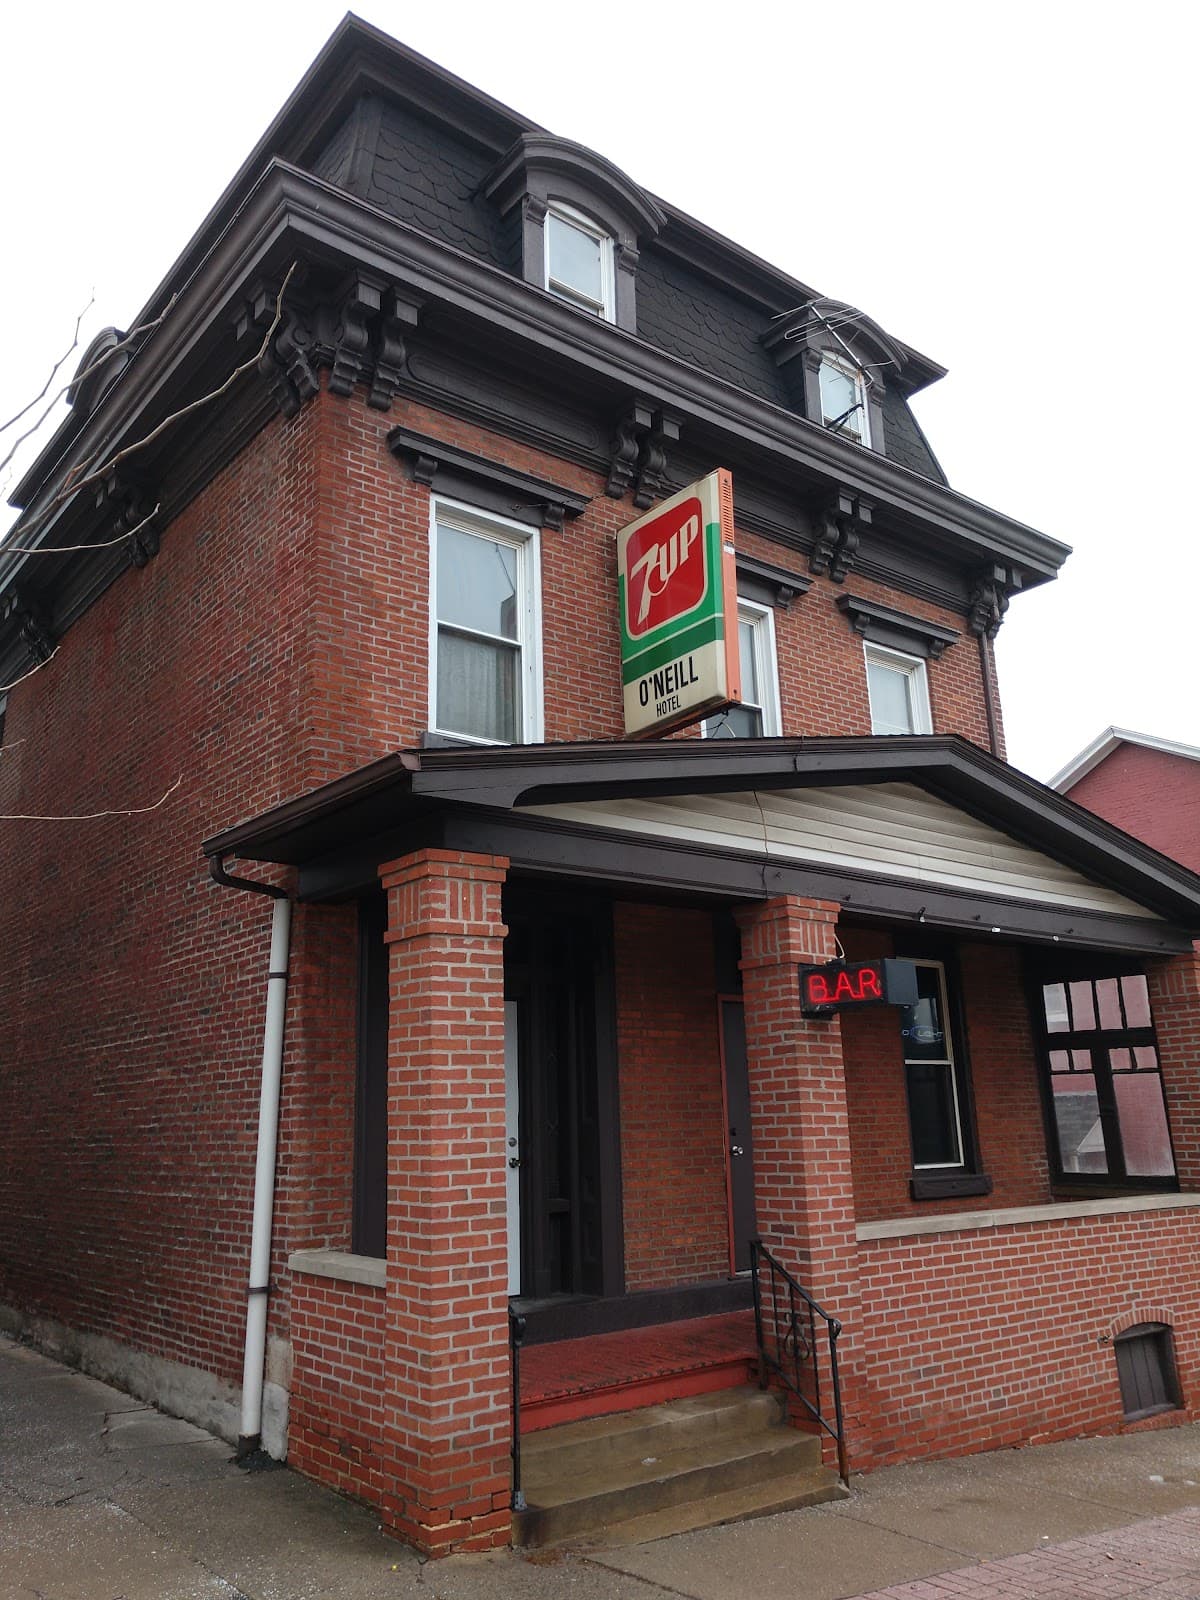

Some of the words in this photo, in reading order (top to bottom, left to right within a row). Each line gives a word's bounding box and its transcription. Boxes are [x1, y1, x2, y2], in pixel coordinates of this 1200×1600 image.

[639, 656, 699, 707] O'NEILL
[656, 695, 681, 717] HOTEL
[809, 969, 881, 1003] BAR
